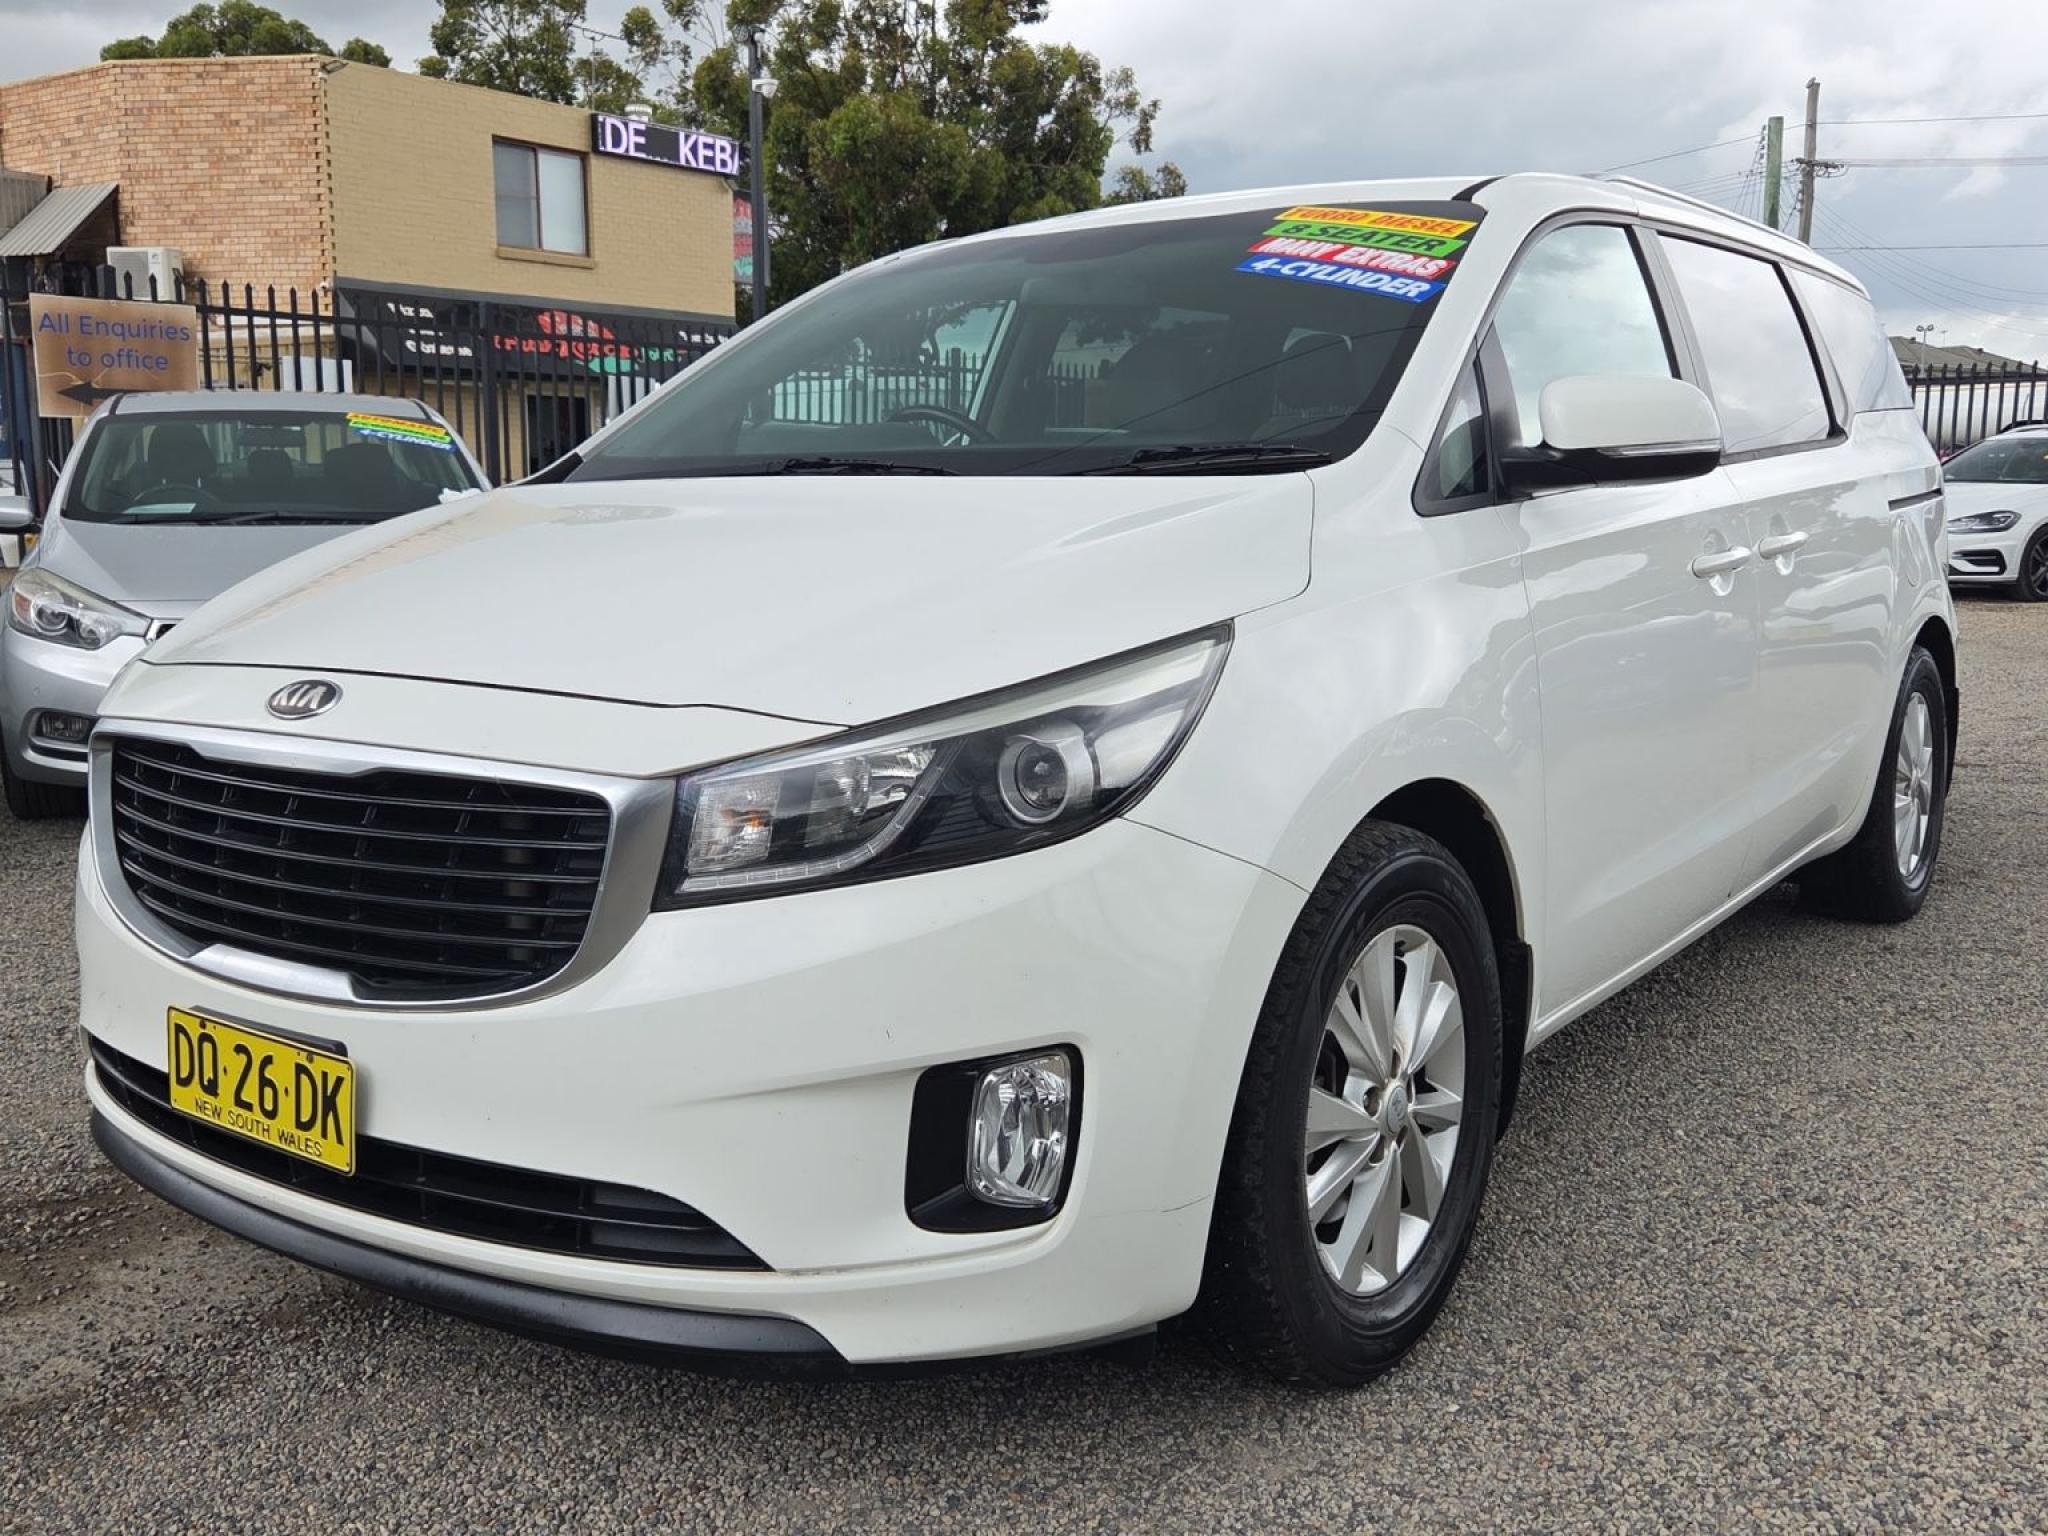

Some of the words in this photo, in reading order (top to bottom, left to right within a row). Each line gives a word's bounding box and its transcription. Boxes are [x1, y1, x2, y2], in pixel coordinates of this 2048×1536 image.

[1309, 225, 1447, 252] SEATER
[1371, 215, 1464, 234] DIESEL
[1257, 237, 1345, 257] MANY
[1333, 246, 1448, 277] EXTRAS
[1250, 257, 1432, 298] 4-CYLINDER
[38, 312, 70, 333] All
[79, 315, 191, 341] Enquiries
[66, 346, 92, 367] to
[101, 348, 170, 370] office
[194, 1095, 222, 1118] NEW
[227, 1109, 270, 1139] SOUTH
[277, 1126, 322, 1157] WALES
